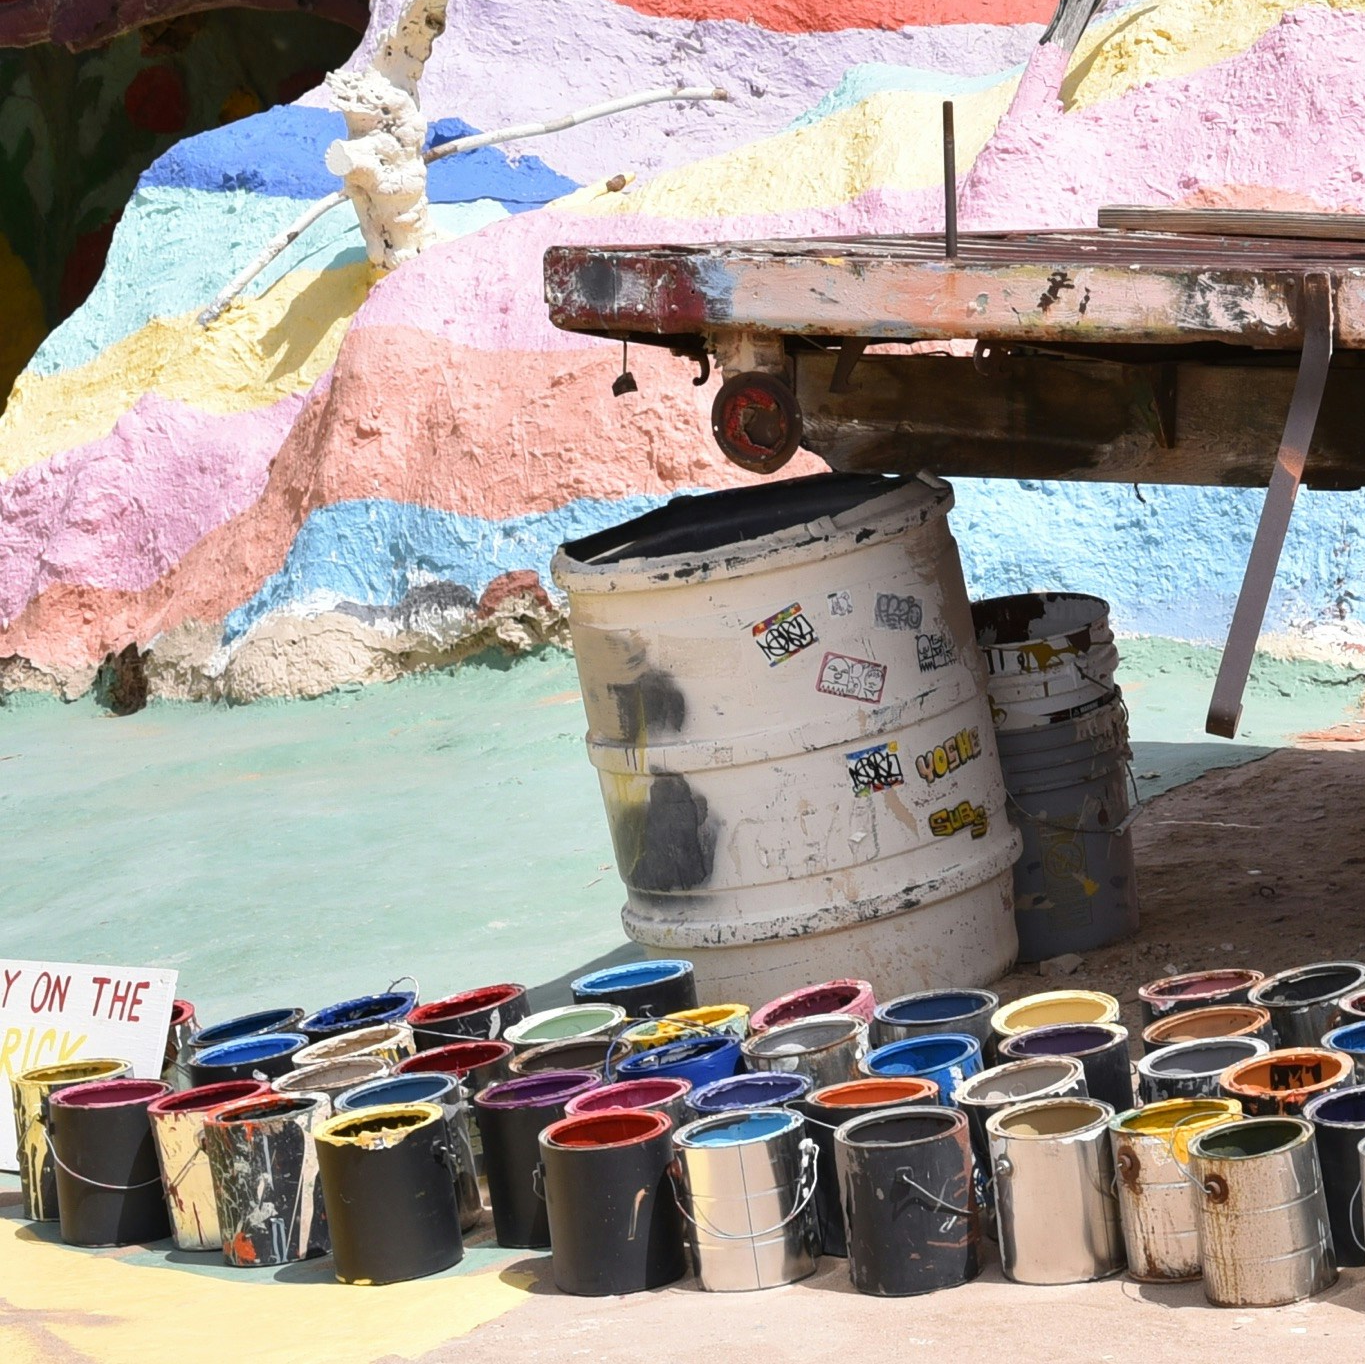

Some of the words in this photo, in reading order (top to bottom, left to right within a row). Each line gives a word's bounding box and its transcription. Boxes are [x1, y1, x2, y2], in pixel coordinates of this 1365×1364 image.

[2, 969, 22, 1009] Y
[30, 971, 73, 1014] ON
[92, 976, 151, 1023] THE
